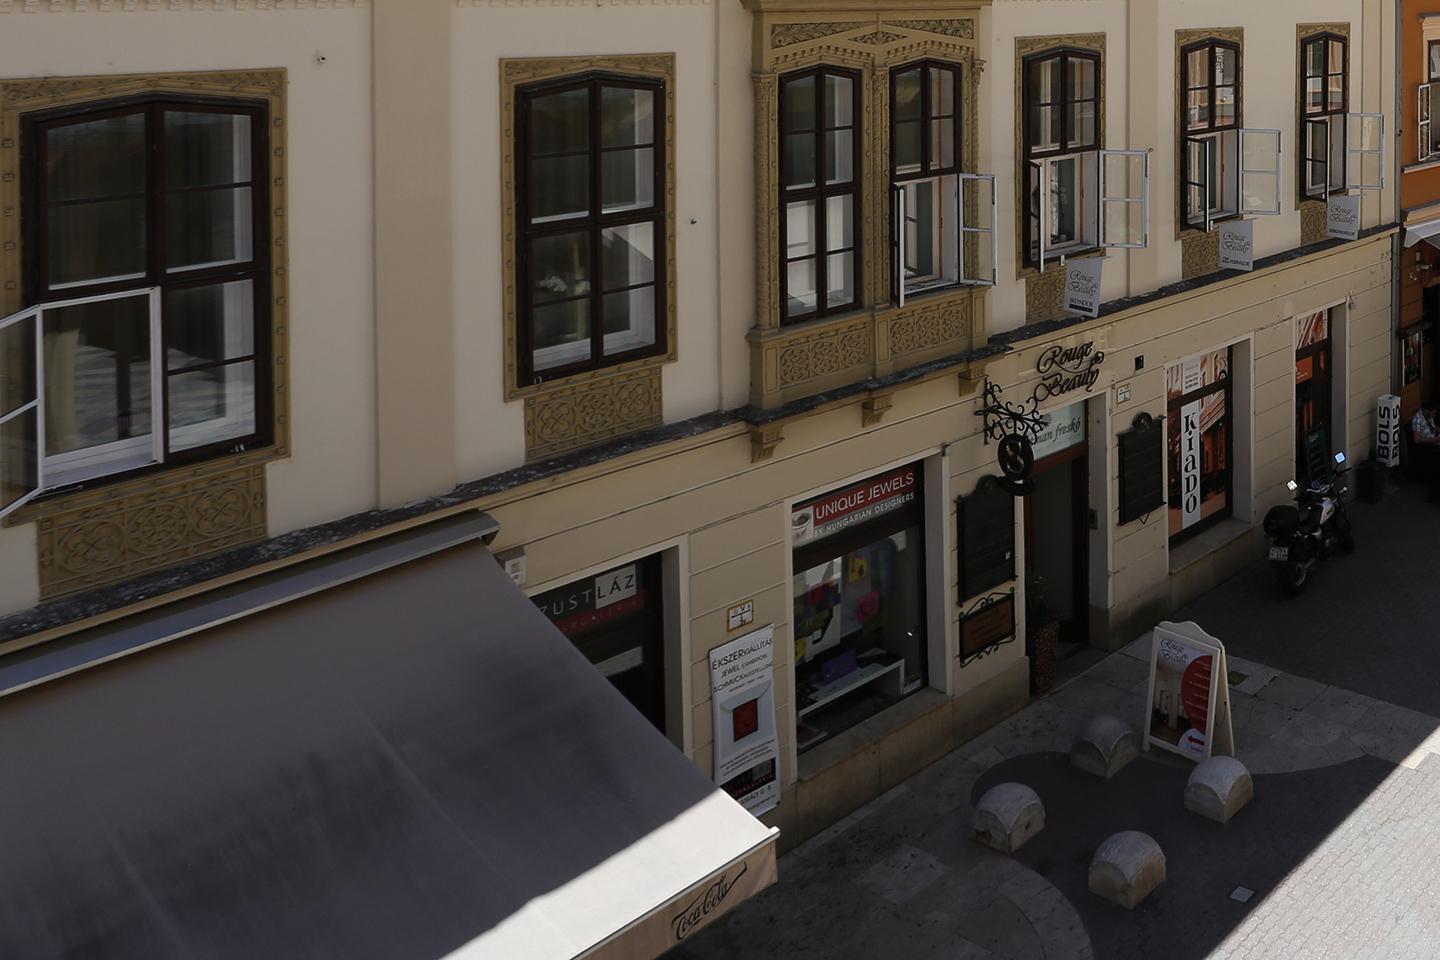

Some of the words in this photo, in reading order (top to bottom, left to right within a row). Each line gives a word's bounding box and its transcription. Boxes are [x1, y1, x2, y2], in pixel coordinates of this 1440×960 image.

[1037, 341, 1094, 373] Rouge
[1034, 369, 1100, 402] Beauty
[1378, 406, 1390, 459] BOLS
[816, 490, 864, 519] UNIQUE
[867, 472, 914, 501] JEWELS
[826, 509, 872, 532] HUNGARIAN
[875, 491, 915, 513] DESIGNERS
